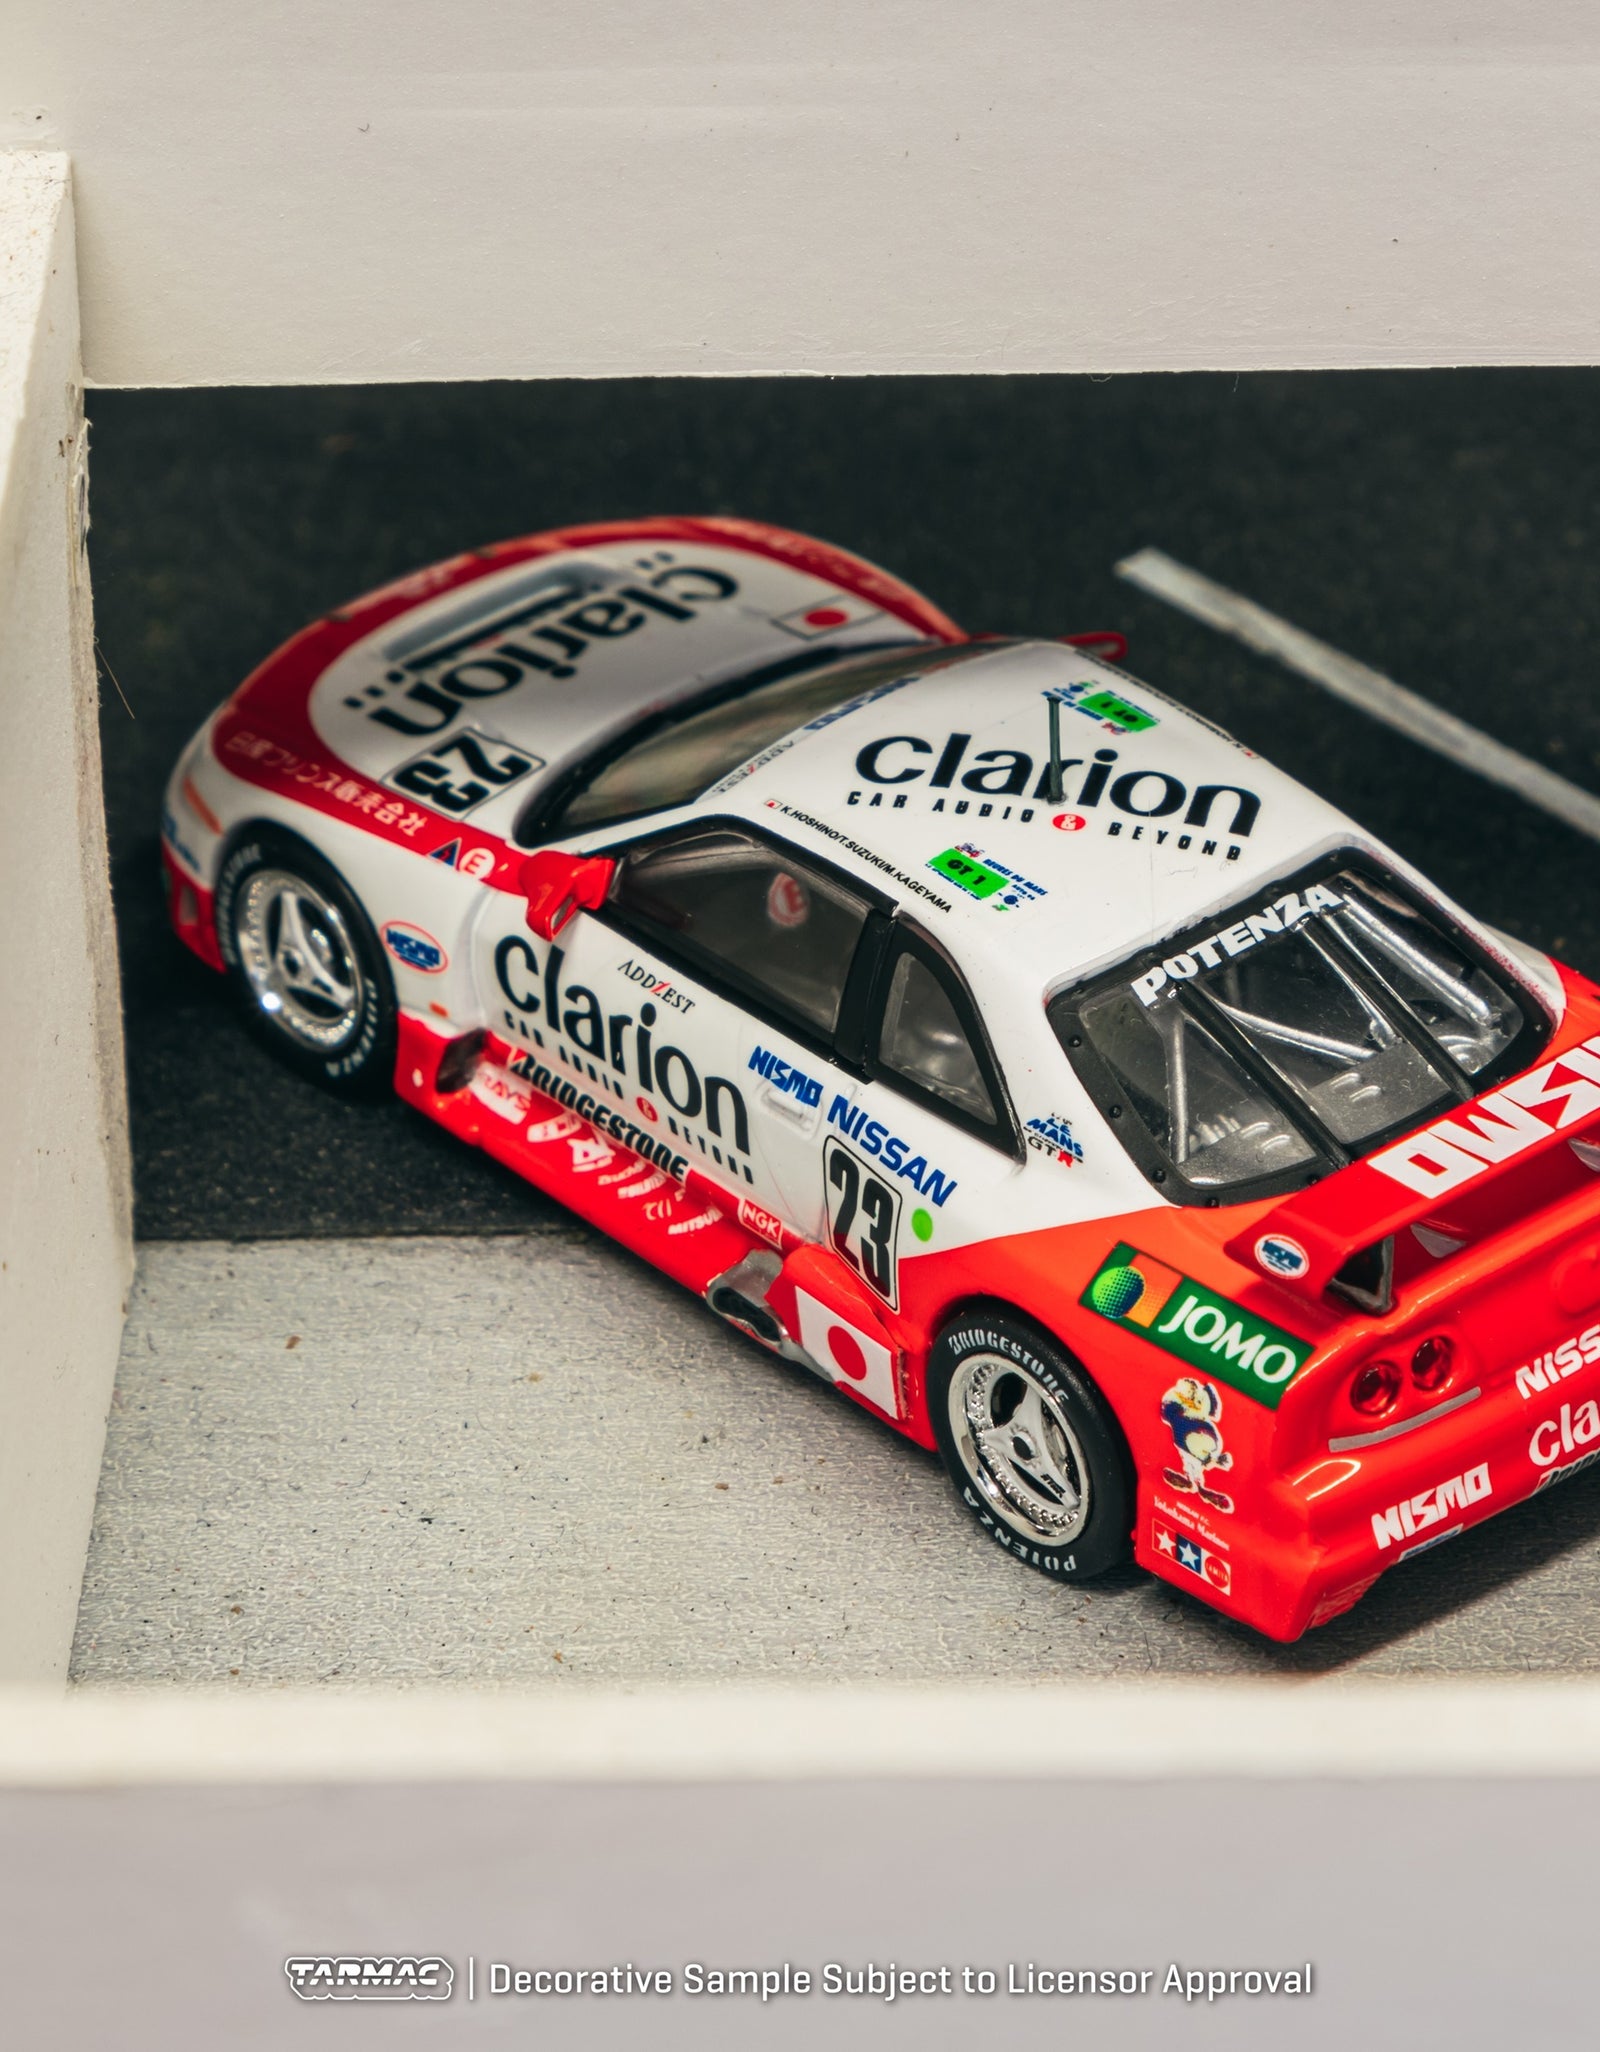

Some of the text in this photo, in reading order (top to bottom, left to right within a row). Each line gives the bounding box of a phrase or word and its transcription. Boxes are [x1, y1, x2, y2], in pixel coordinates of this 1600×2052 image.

[393, 734, 533, 814] 23
[855, 732, 1262, 838] clarion
[847, 790, 907, 810] CAR
[932, 797, 1035, 824] AUDIO
[1107, 821, 1243, 861] BEYOND
[946, 859, 987, 886] GT 1
[617, 959, 696, 1015] ADDZEST
[1130, 883, 1345, 1008] POTENZA
[494, 934, 752, 1158] clarion
[748, 1045, 824, 1108] NISMO
[507, 1050, 690, 1183] BRIDGESTONE
[827, 1094, 958, 1208] NISSAN
[1026, 1118, 1084, 1158] MANS
[1045, 1117, 1071, 1137] LE
[743, 1203, 782, 1239] NGK
[829, 1147, 895, 1298] 23
[1158, 1294, 1297, 1384] JOMO
[963, 1485, 1077, 1573] POTENZA
[1371, 1462, 1493, 1550] NISMO
